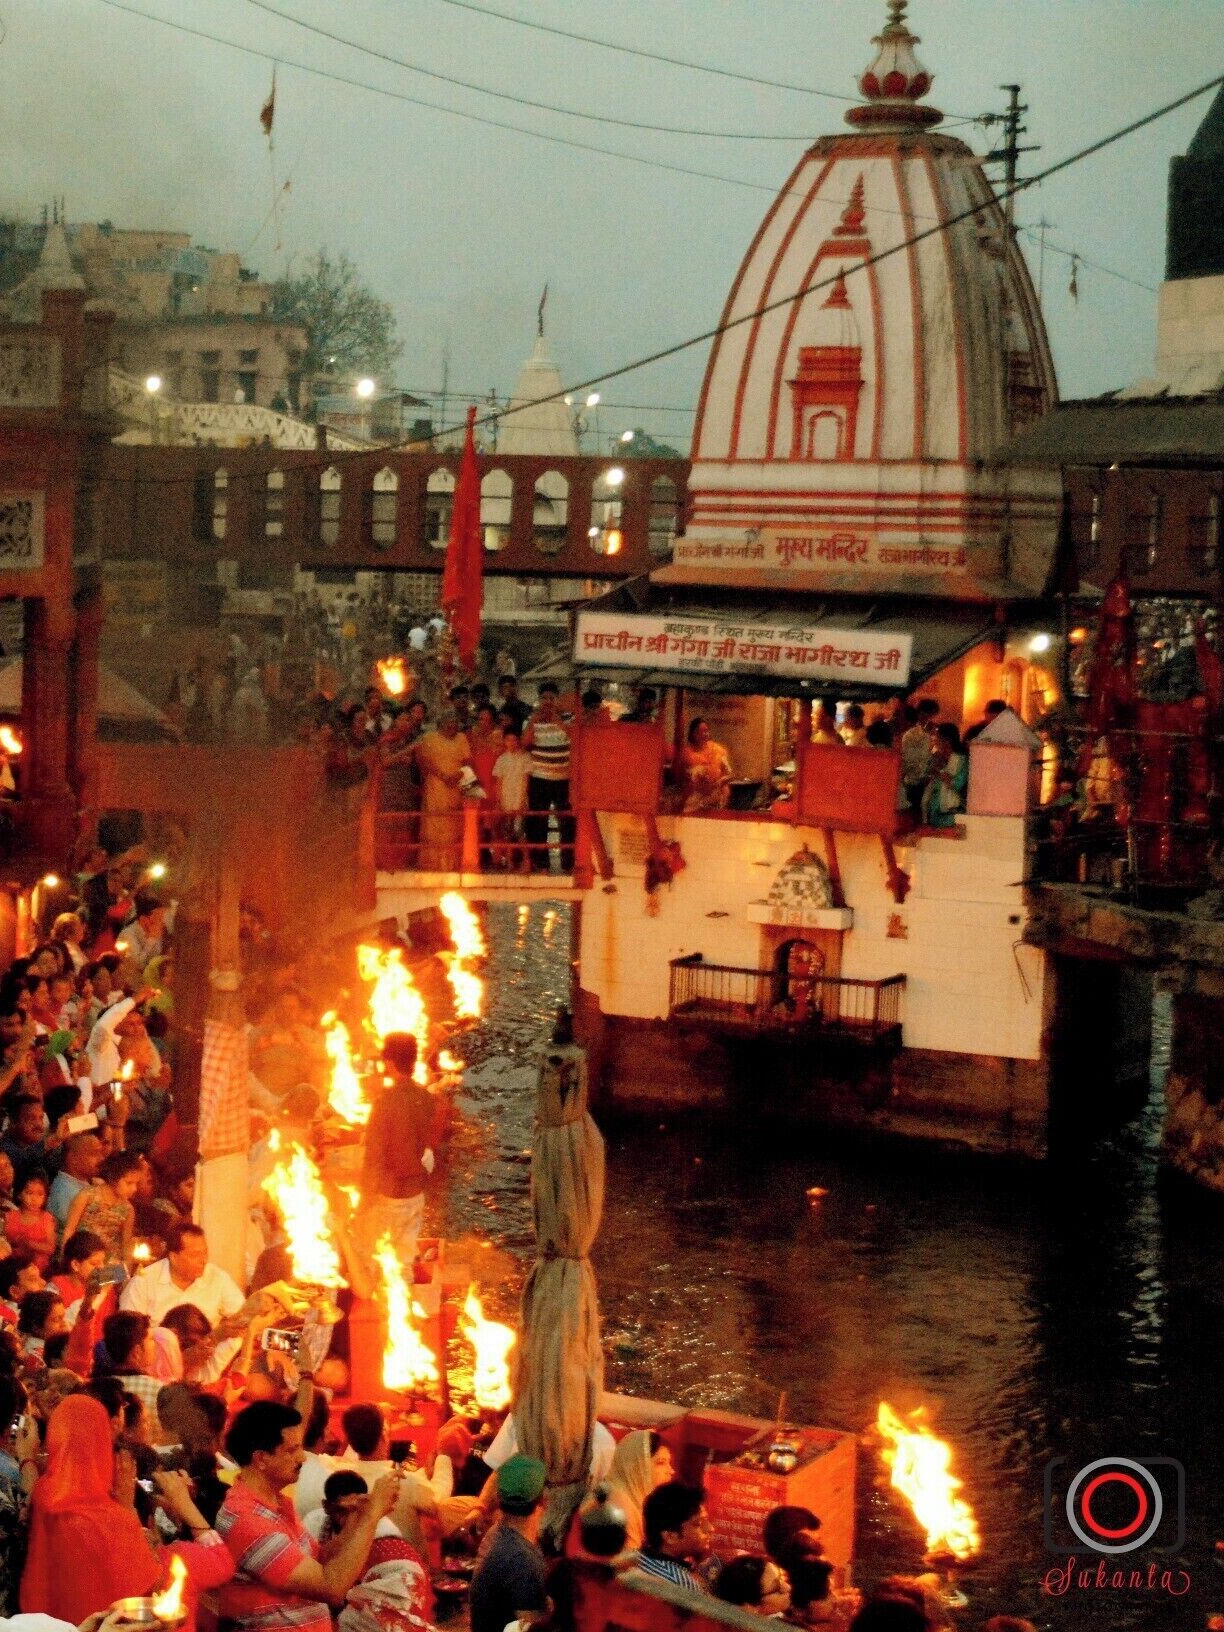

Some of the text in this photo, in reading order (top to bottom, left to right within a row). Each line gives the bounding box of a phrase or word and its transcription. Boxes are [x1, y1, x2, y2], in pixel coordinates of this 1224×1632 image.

[583, 631, 643, 651] प्राचीन
[645, 633, 669, 655] श्री
[712, 638, 736, 658] जी
[738, 643, 782, 663] राजा
[784, 644, 870, 669] भागीरथ
[875, 648, 901, 670] जी
